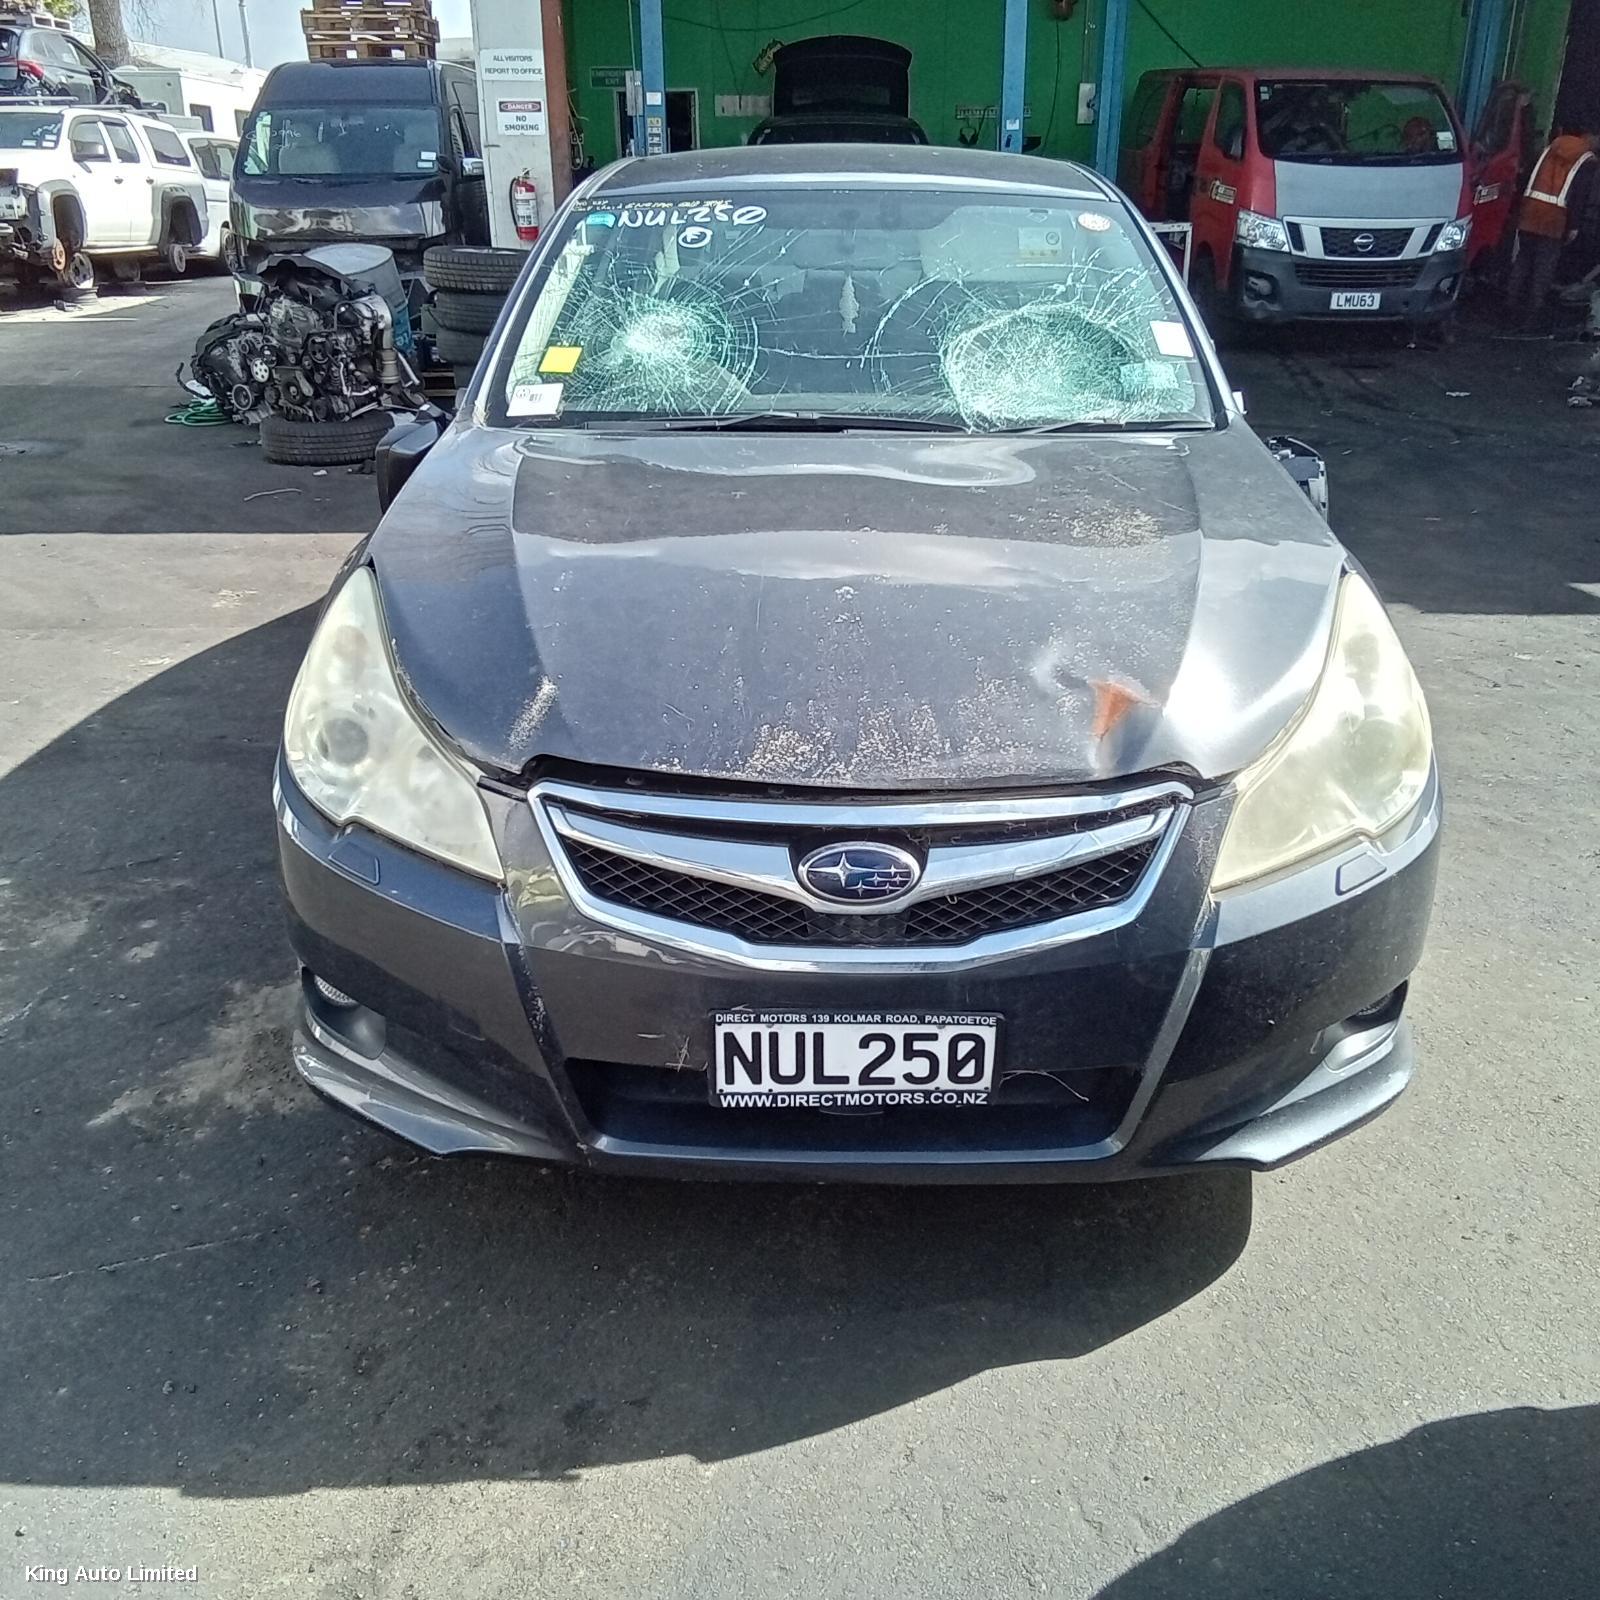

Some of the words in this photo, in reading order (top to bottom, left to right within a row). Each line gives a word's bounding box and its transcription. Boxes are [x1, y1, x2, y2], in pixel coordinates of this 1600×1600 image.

[1336, 294, 1375, 308] LMU63
[715, 1013, 756, 1023] DIRECT
[759, 1014, 807, 1023] MOTORS
[811, 1014, 830, 1023] 139
[833, 1014, 881, 1023] KOLMAR
[885, 1014, 921, 1024] ROAD,
[924, 1015, 997, 1025] PAPATOETOE
[723, 1031, 986, 1086] NUL250
[720, 1092, 988, 1108] WWW.DIRECTMOTORS.CO.NZ
